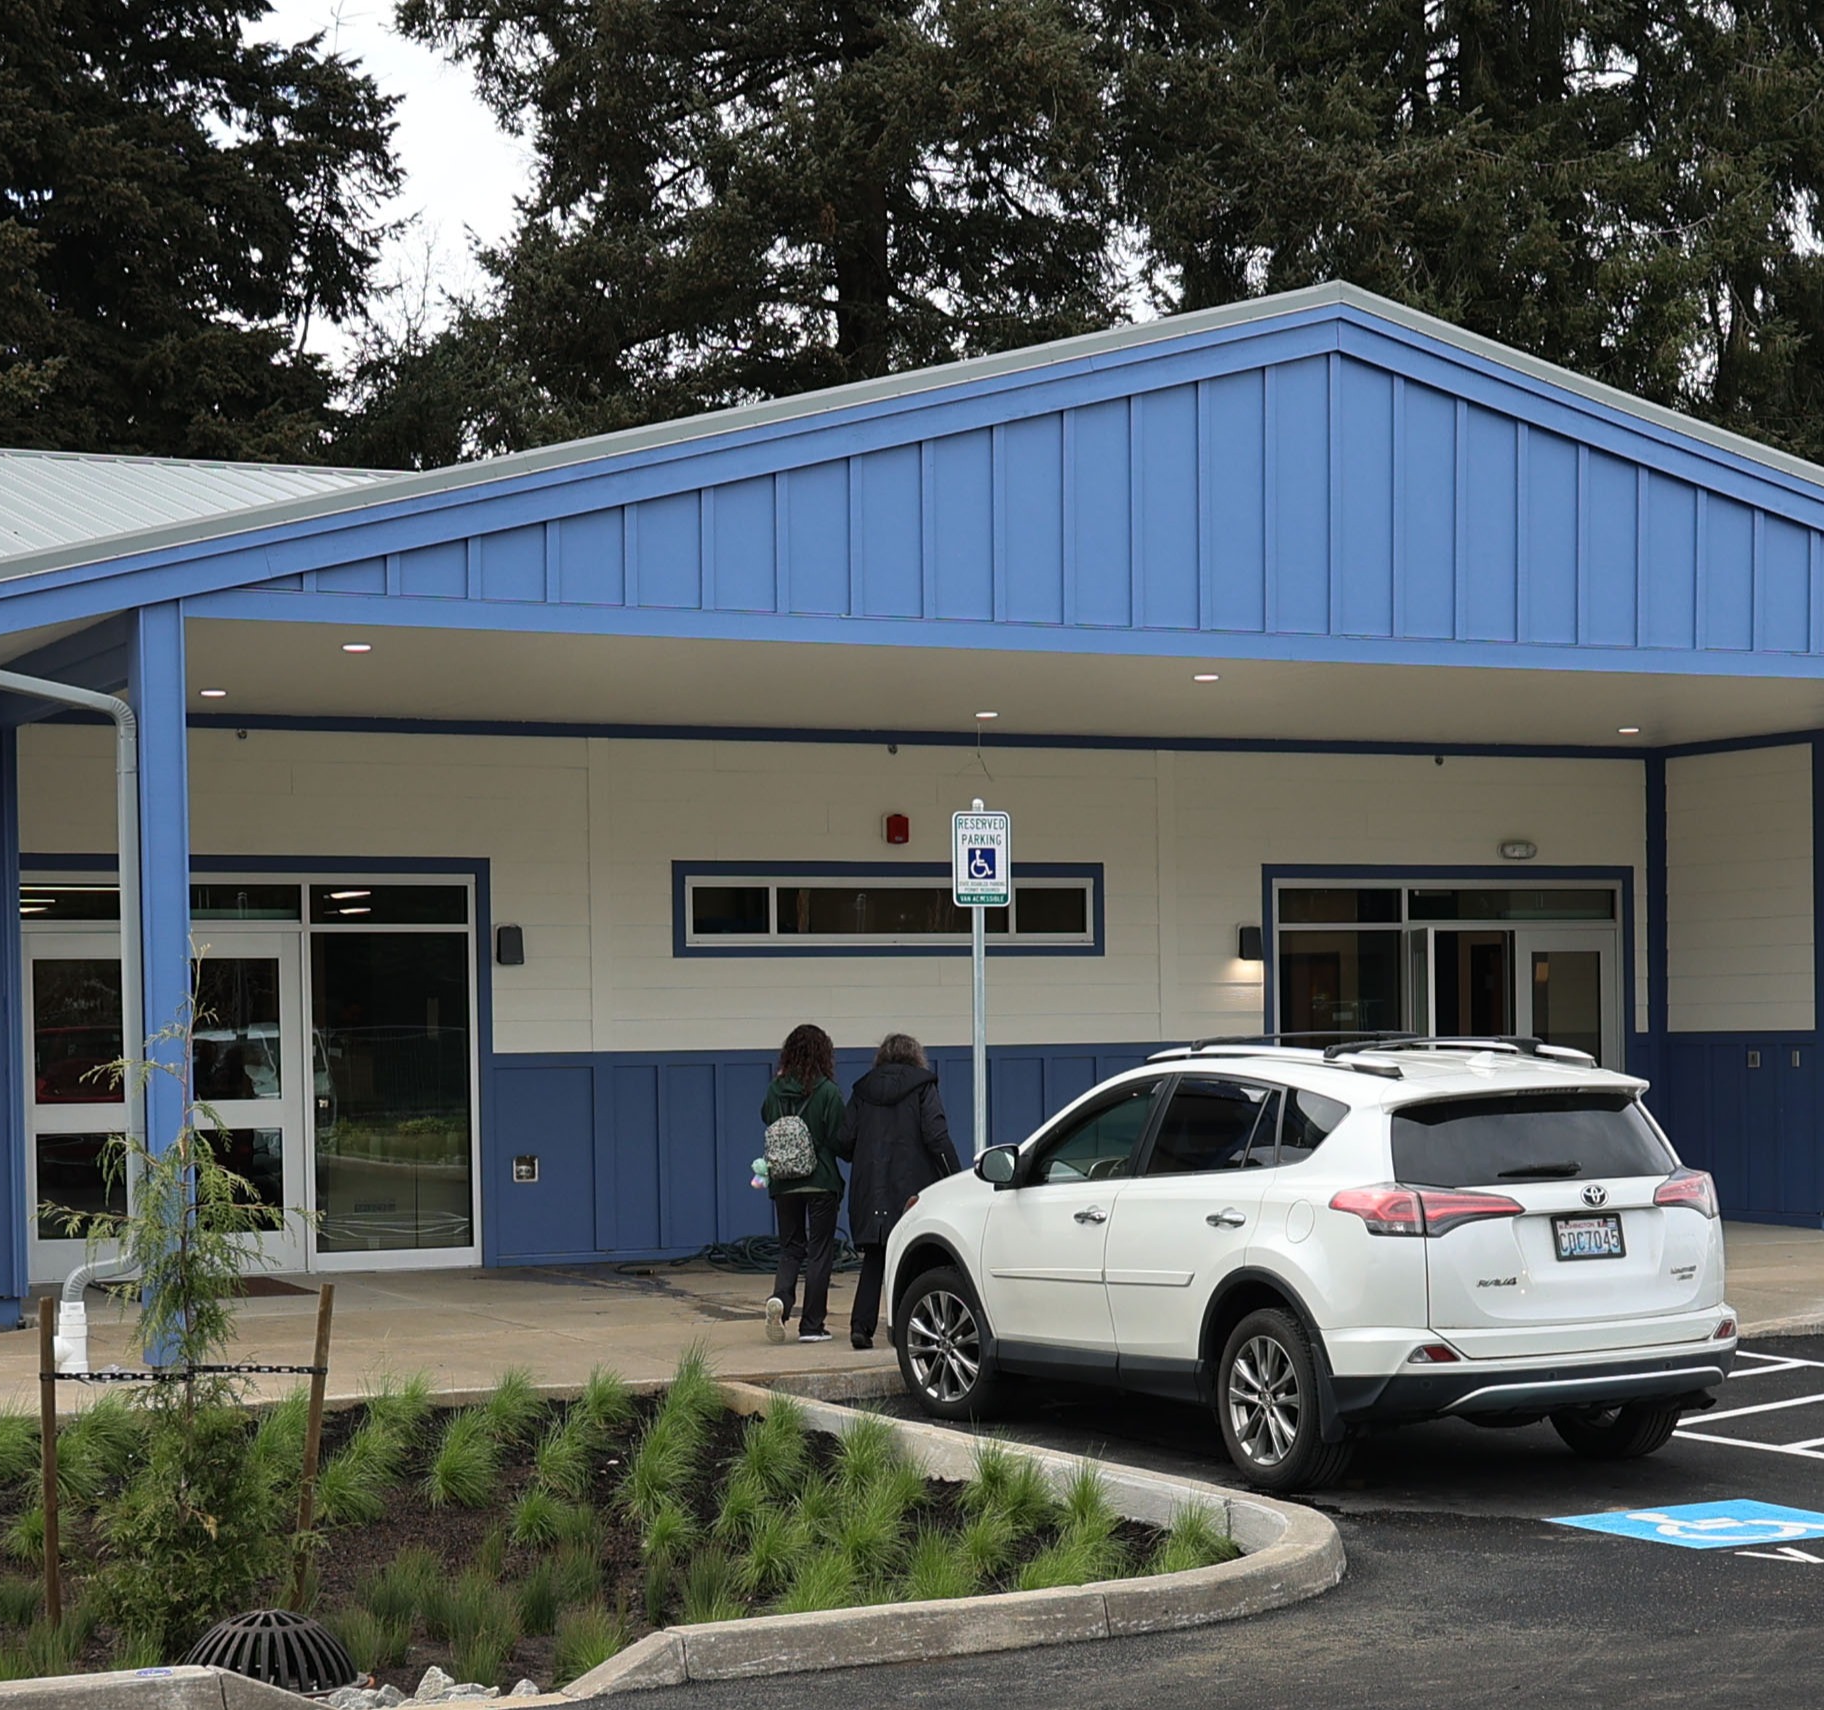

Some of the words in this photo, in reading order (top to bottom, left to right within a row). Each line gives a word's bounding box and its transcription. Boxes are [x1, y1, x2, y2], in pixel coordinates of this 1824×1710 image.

[958, 818, 1005, 830] RESERVED
[961, 834, 1002, 846] PARKING
[1559, 1229, 1620, 1252] CDC7045
